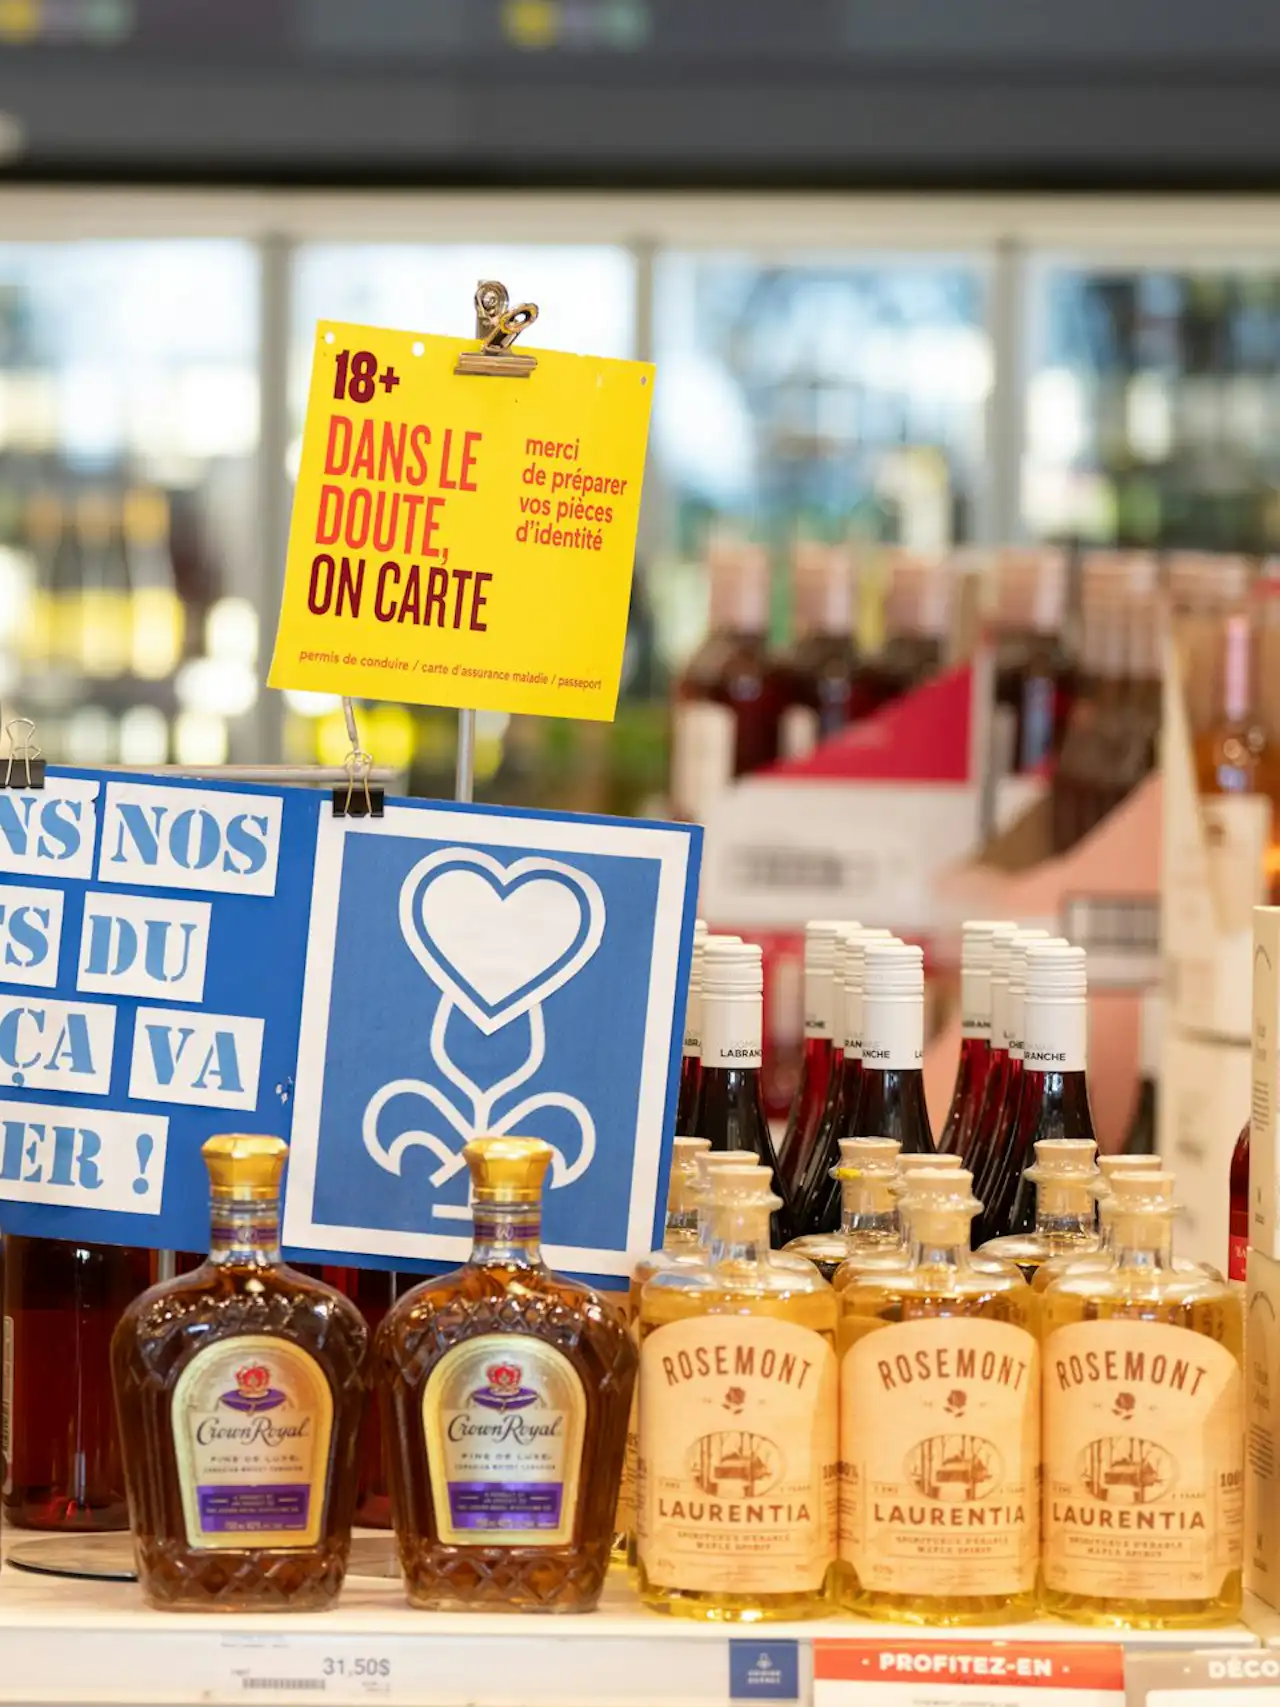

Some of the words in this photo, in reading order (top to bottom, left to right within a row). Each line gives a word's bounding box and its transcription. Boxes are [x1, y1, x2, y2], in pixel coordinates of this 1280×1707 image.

[333, 350, 400, 403] 18+
[324, 414, 431, 489] DANS
[439, 428, 482, 492] LE
[525, 438, 579, 461] merci
[522, 463, 547, 486] de
[551, 469, 627, 498] préparer
[315, 485, 448, 564] DOUTE,
[519, 497, 551, 517] vos
[557, 498, 614, 524] pièces
[515, 522, 604, 551] d'identité
[307, 554, 365, 619] ON
[374, 561, 493, 632] CARTE
[299, 650, 339, 664] permis
[343, 653, 357, 665] de
[360, 657, 409, 671] conduire
[421, 663, 449, 674] carte
[451, 664, 510, 681] d'assurance
[512, 672, 549, 684] maladie
[557, 677, 602, 692] passeport
[111, 803, 269, 875] NOS
[85, 915, 197, 982] DU
[146, 1025, 245, 1092] VA
[131, 1134, 155, 1194] !
[662, 1345, 812, 1389] ROSEMONT
[878, 1348, 1026, 1391] ROSEMONT
[1056, 1350, 1207, 1396] ROSEMONT
[197, 1417, 251, 1446] Crown
[241, 1416, 310, 1447] Royal
[448, 1414, 502, 1442] Crown
[492, 1415, 563, 1445] Royal
[659, 1499, 810, 1523] LAURENTIA
[874, 1503, 1025, 1526] LAURENTIA
[1053, 1502, 1205, 1530] LAURENTIA
[879, 1652, 1052, 1677] PROFITEZ-EN
